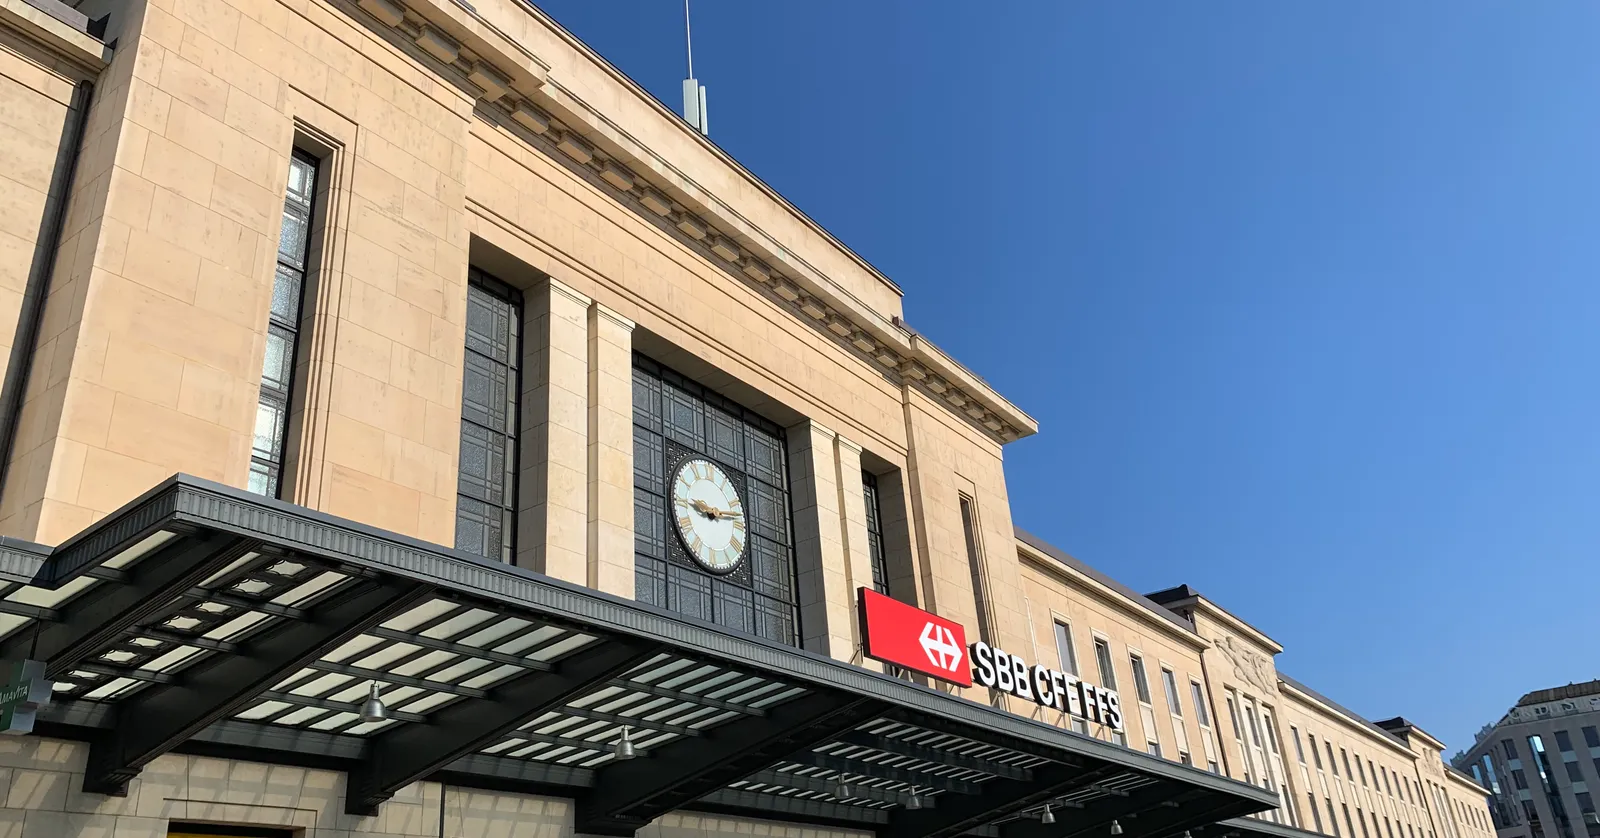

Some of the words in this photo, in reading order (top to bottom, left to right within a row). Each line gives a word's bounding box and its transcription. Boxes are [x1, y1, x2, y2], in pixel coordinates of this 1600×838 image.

[970, 641, 1031, 701] SBB
[1031, 664, 1082, 717] CFF
[1077, 681, 1122, 730] FFS
